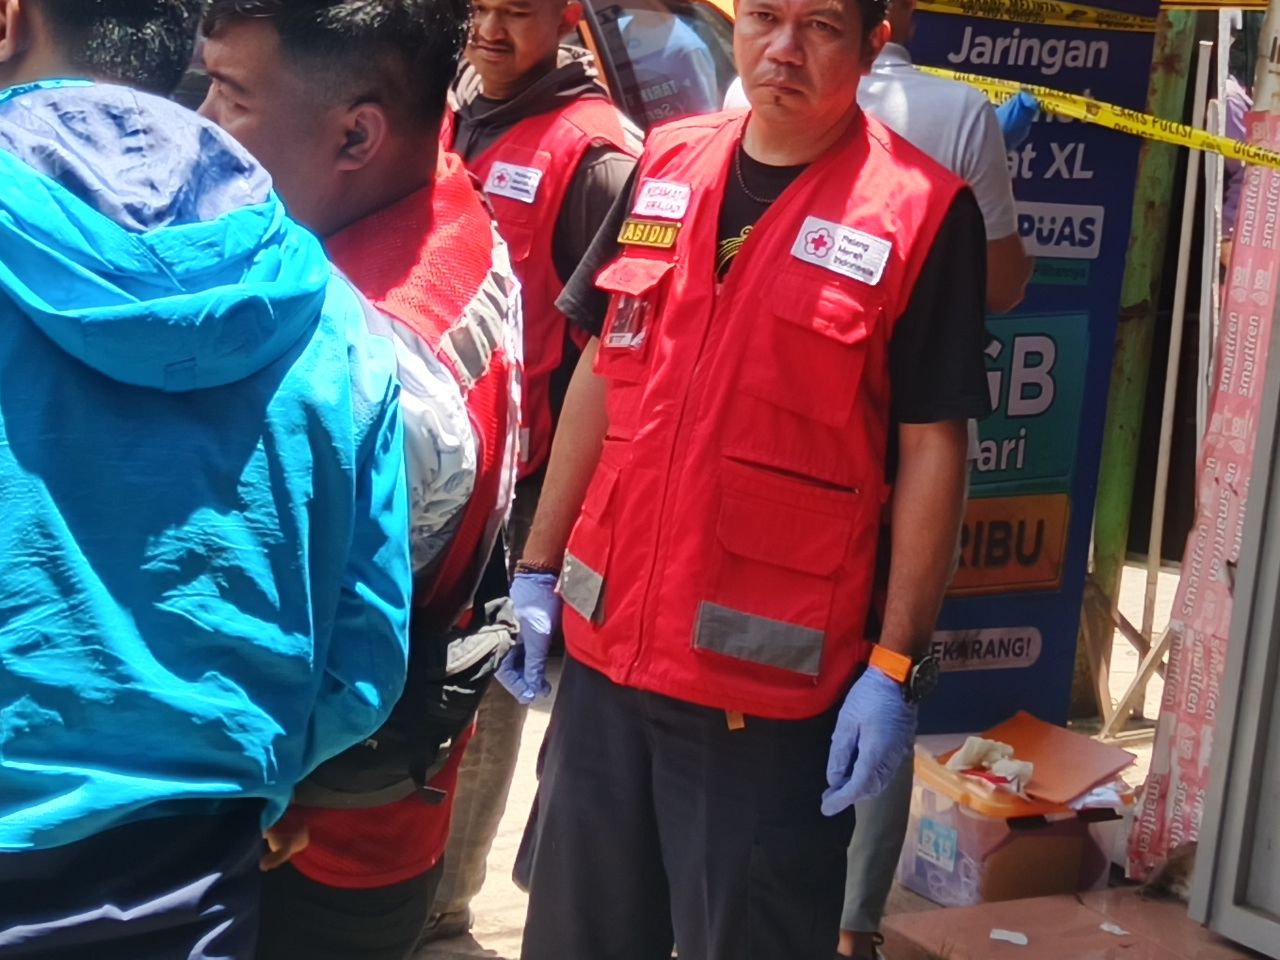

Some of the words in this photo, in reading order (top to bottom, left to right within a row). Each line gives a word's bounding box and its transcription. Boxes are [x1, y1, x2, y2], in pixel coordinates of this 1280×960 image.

[947, 26, 1109, 76] Jaringan
[1007, 143, 1037, 179] at
[1043, 142, 1095, 179] XL
[1238, 315, 1261, 398] smartfren
[968, 420, 1027, 473] ari
[930, 637, 1032, 661] EKARANG!
